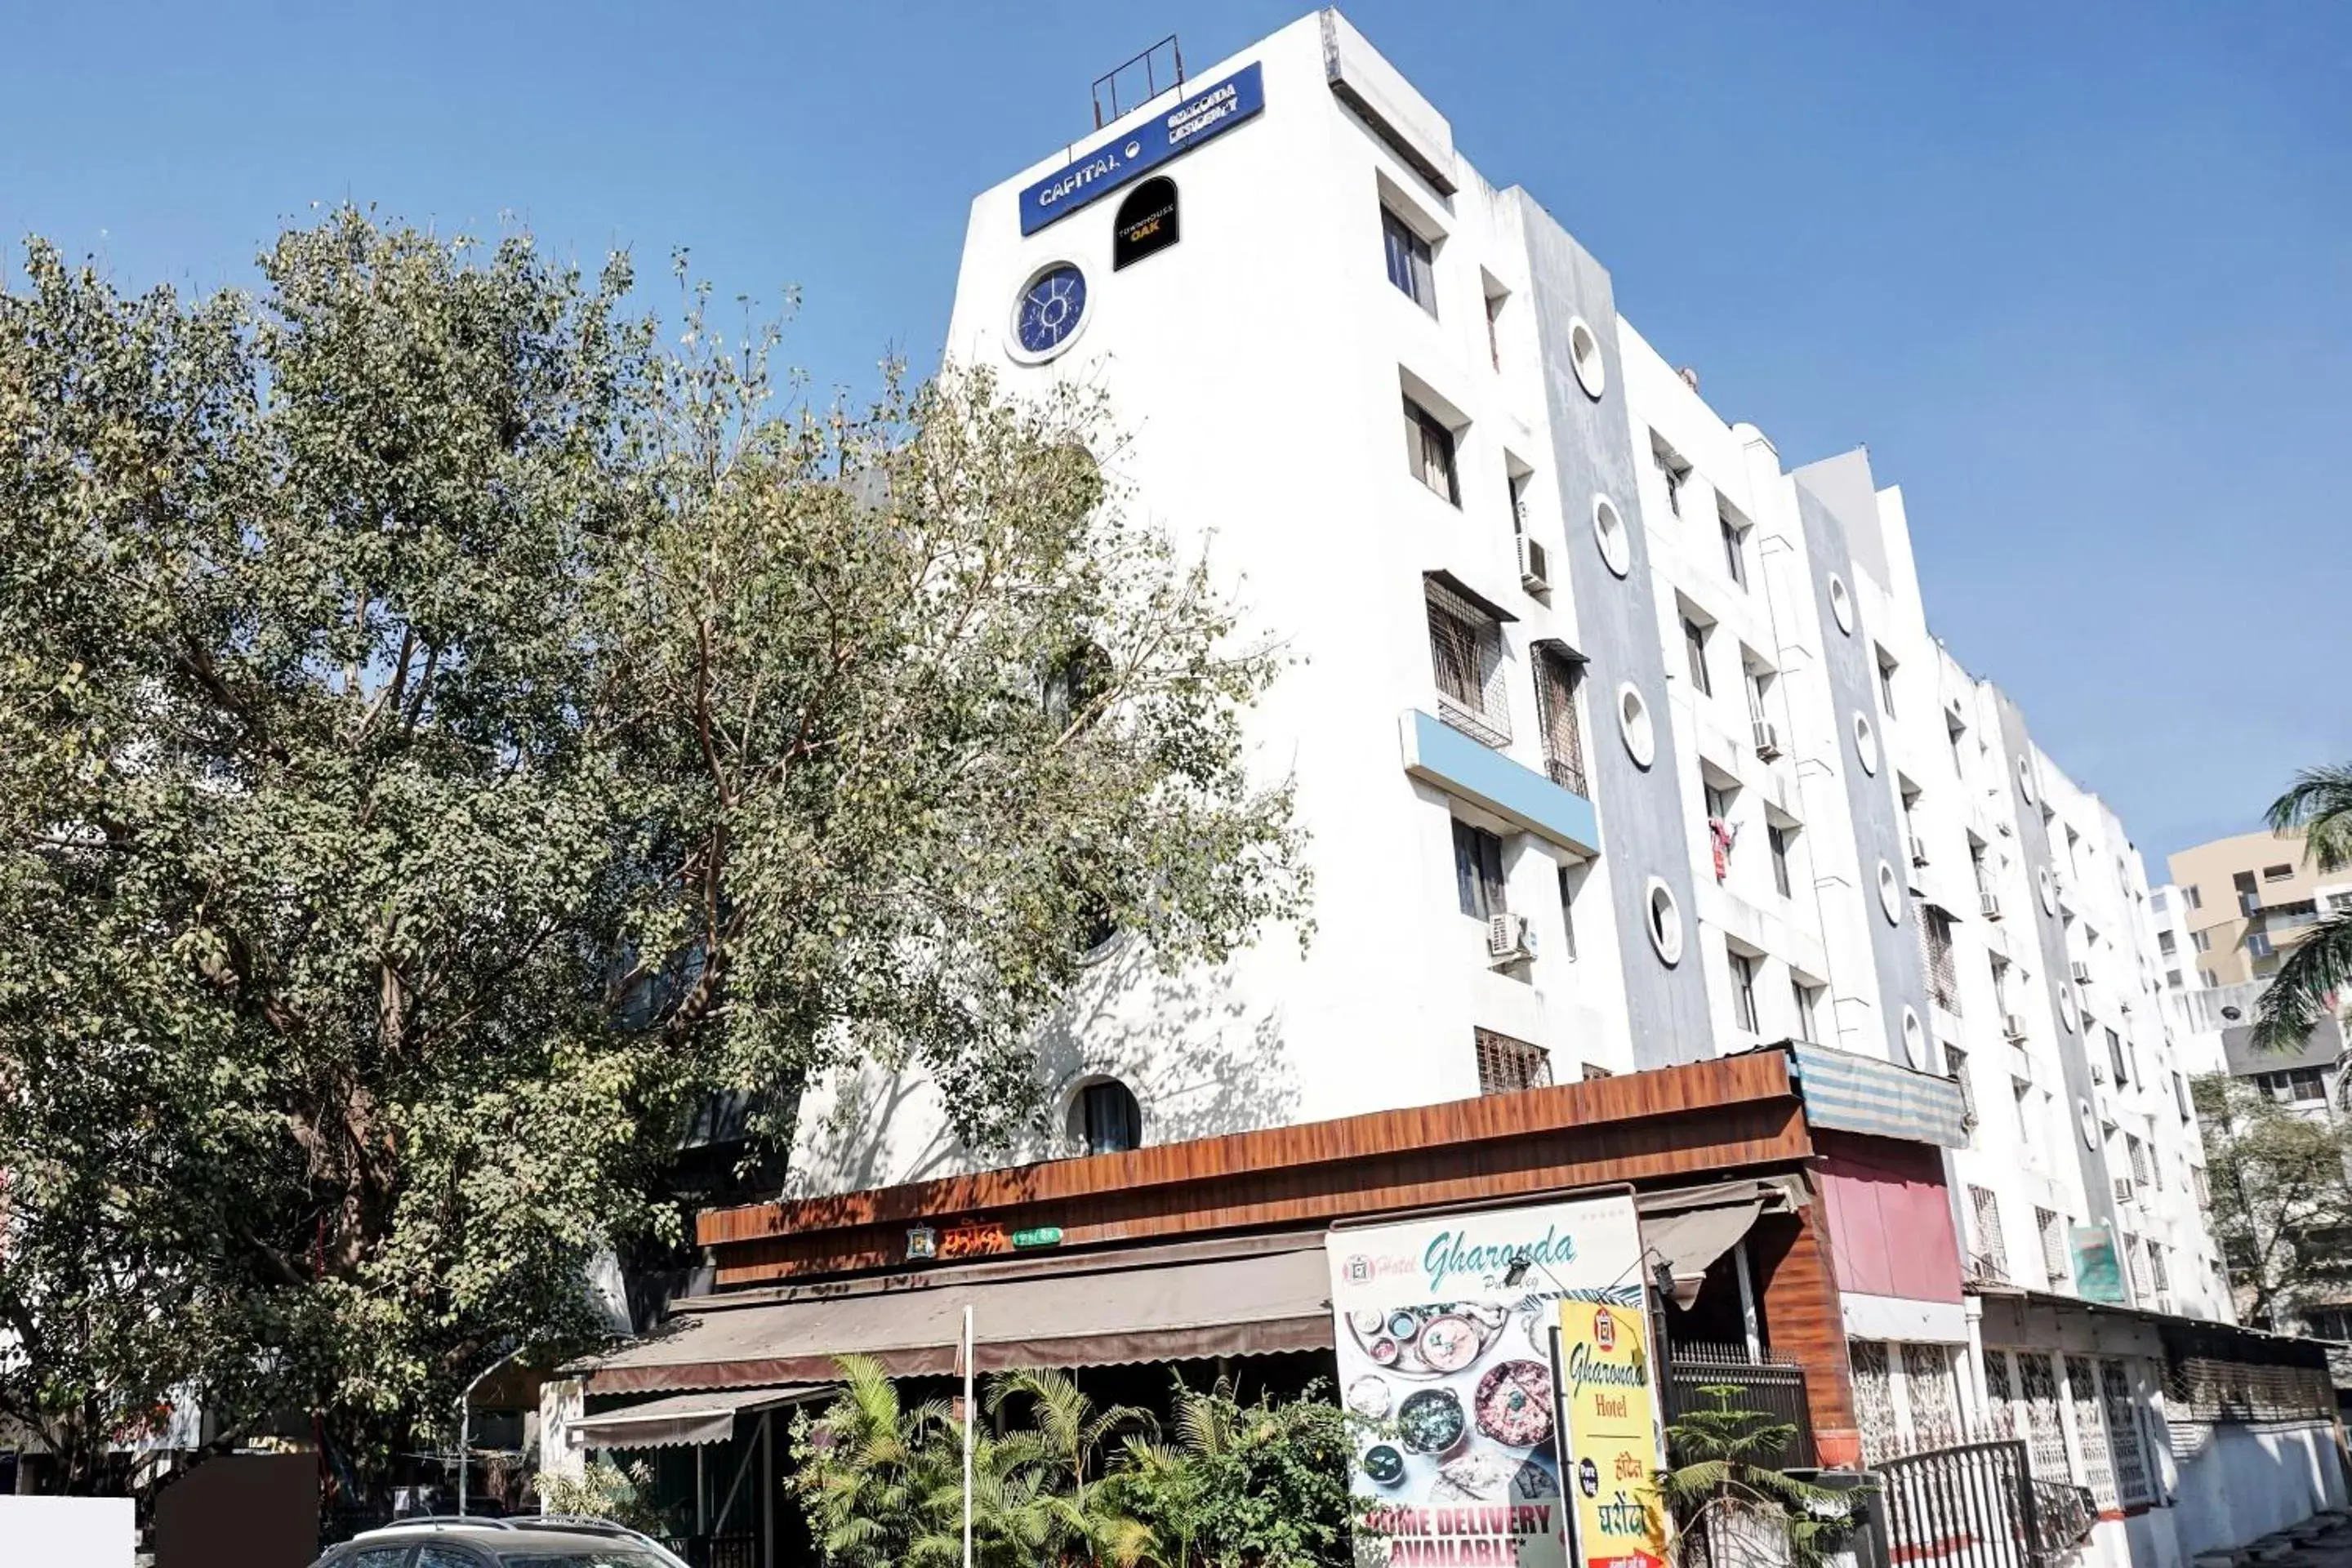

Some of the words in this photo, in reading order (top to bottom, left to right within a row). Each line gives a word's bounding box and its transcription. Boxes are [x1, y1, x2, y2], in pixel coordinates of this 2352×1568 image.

[1130, 219, 1160, 243] OAK
[1570, 1341, 1647, 1399] Gharonda
[1595, 1393, 1628, 1418] Hotel
[1437, 1504, 1552, 1536] DELIVERY
